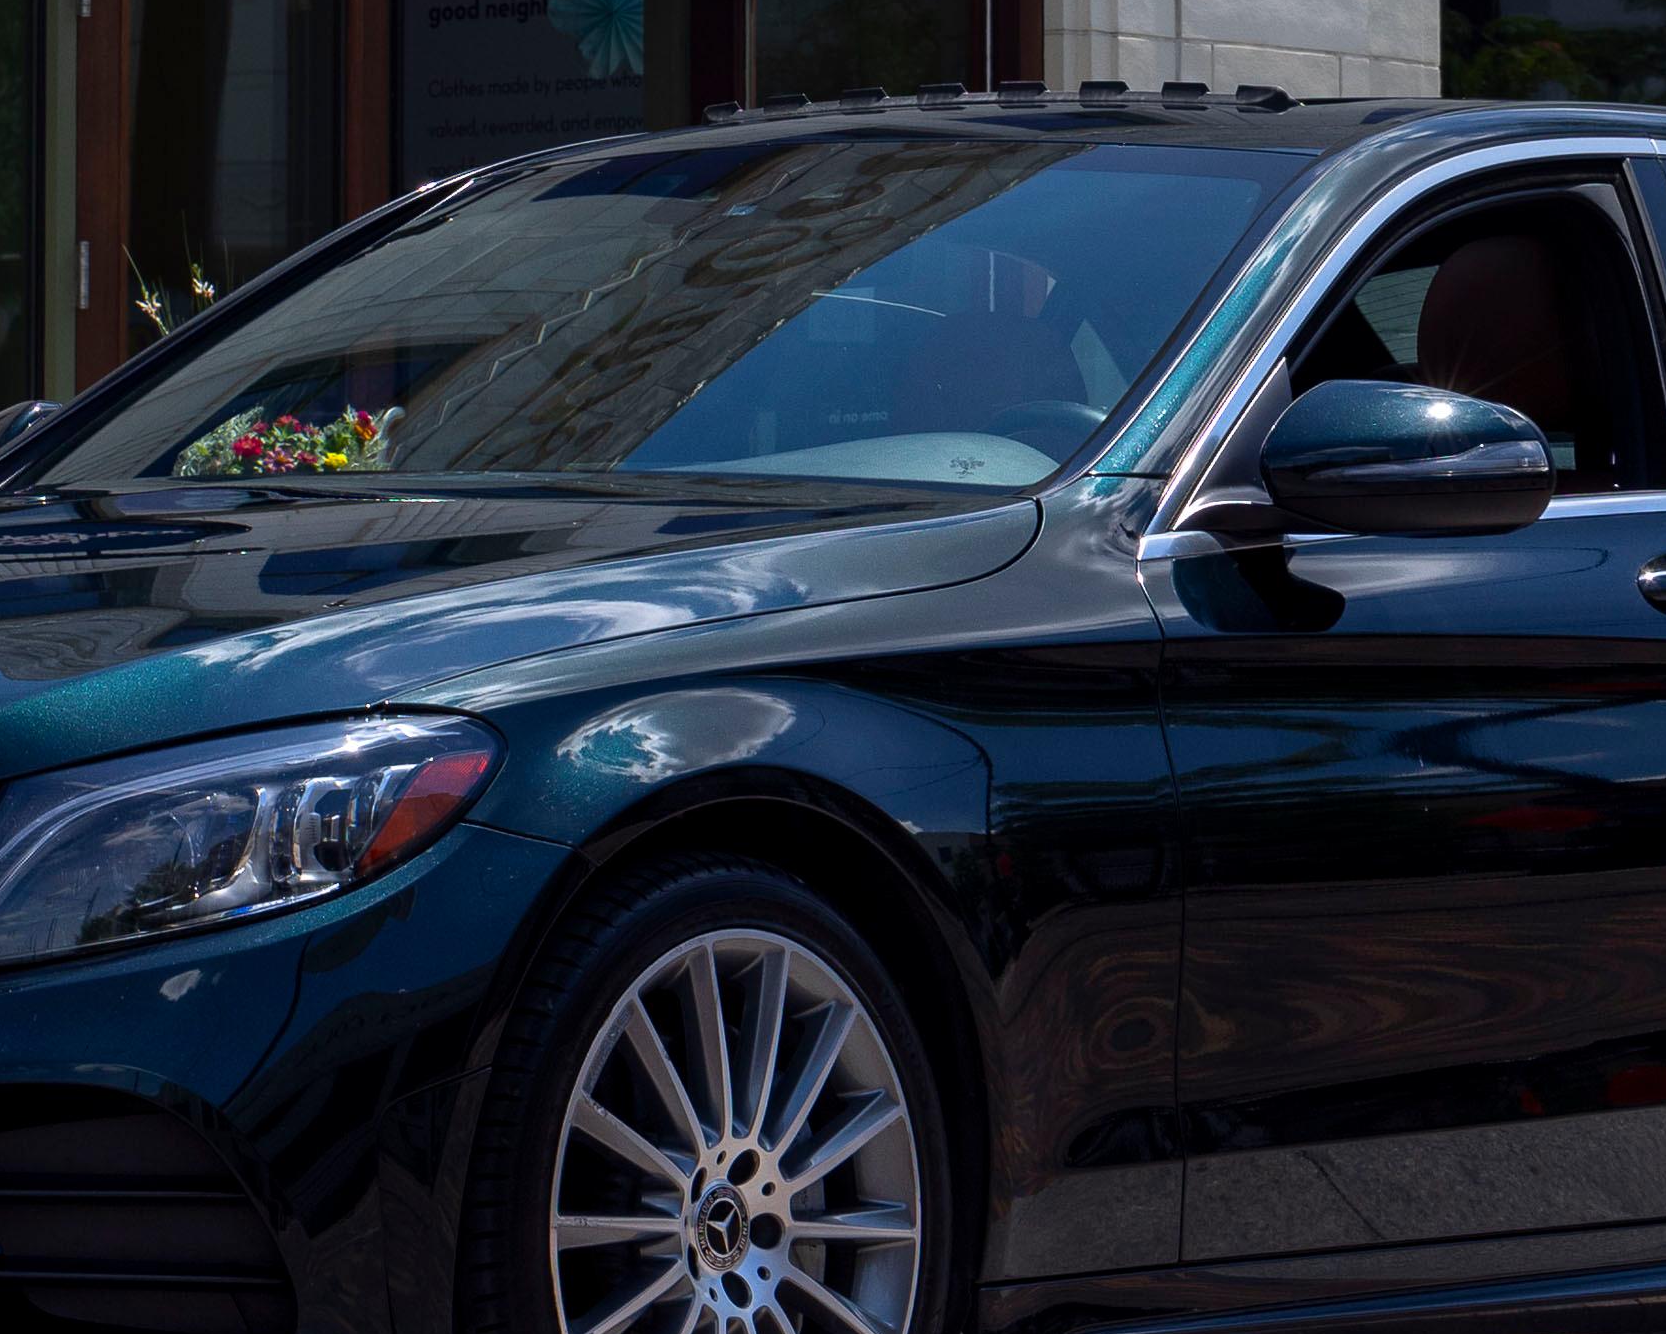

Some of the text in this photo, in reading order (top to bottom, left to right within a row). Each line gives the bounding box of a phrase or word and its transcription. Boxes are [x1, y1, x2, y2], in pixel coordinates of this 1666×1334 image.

[428, 75, 484, 99] Clothes
[488, 74, 529, 96] made
[534, 73, 551, 96] by
[561, 111, 590, 132] and
